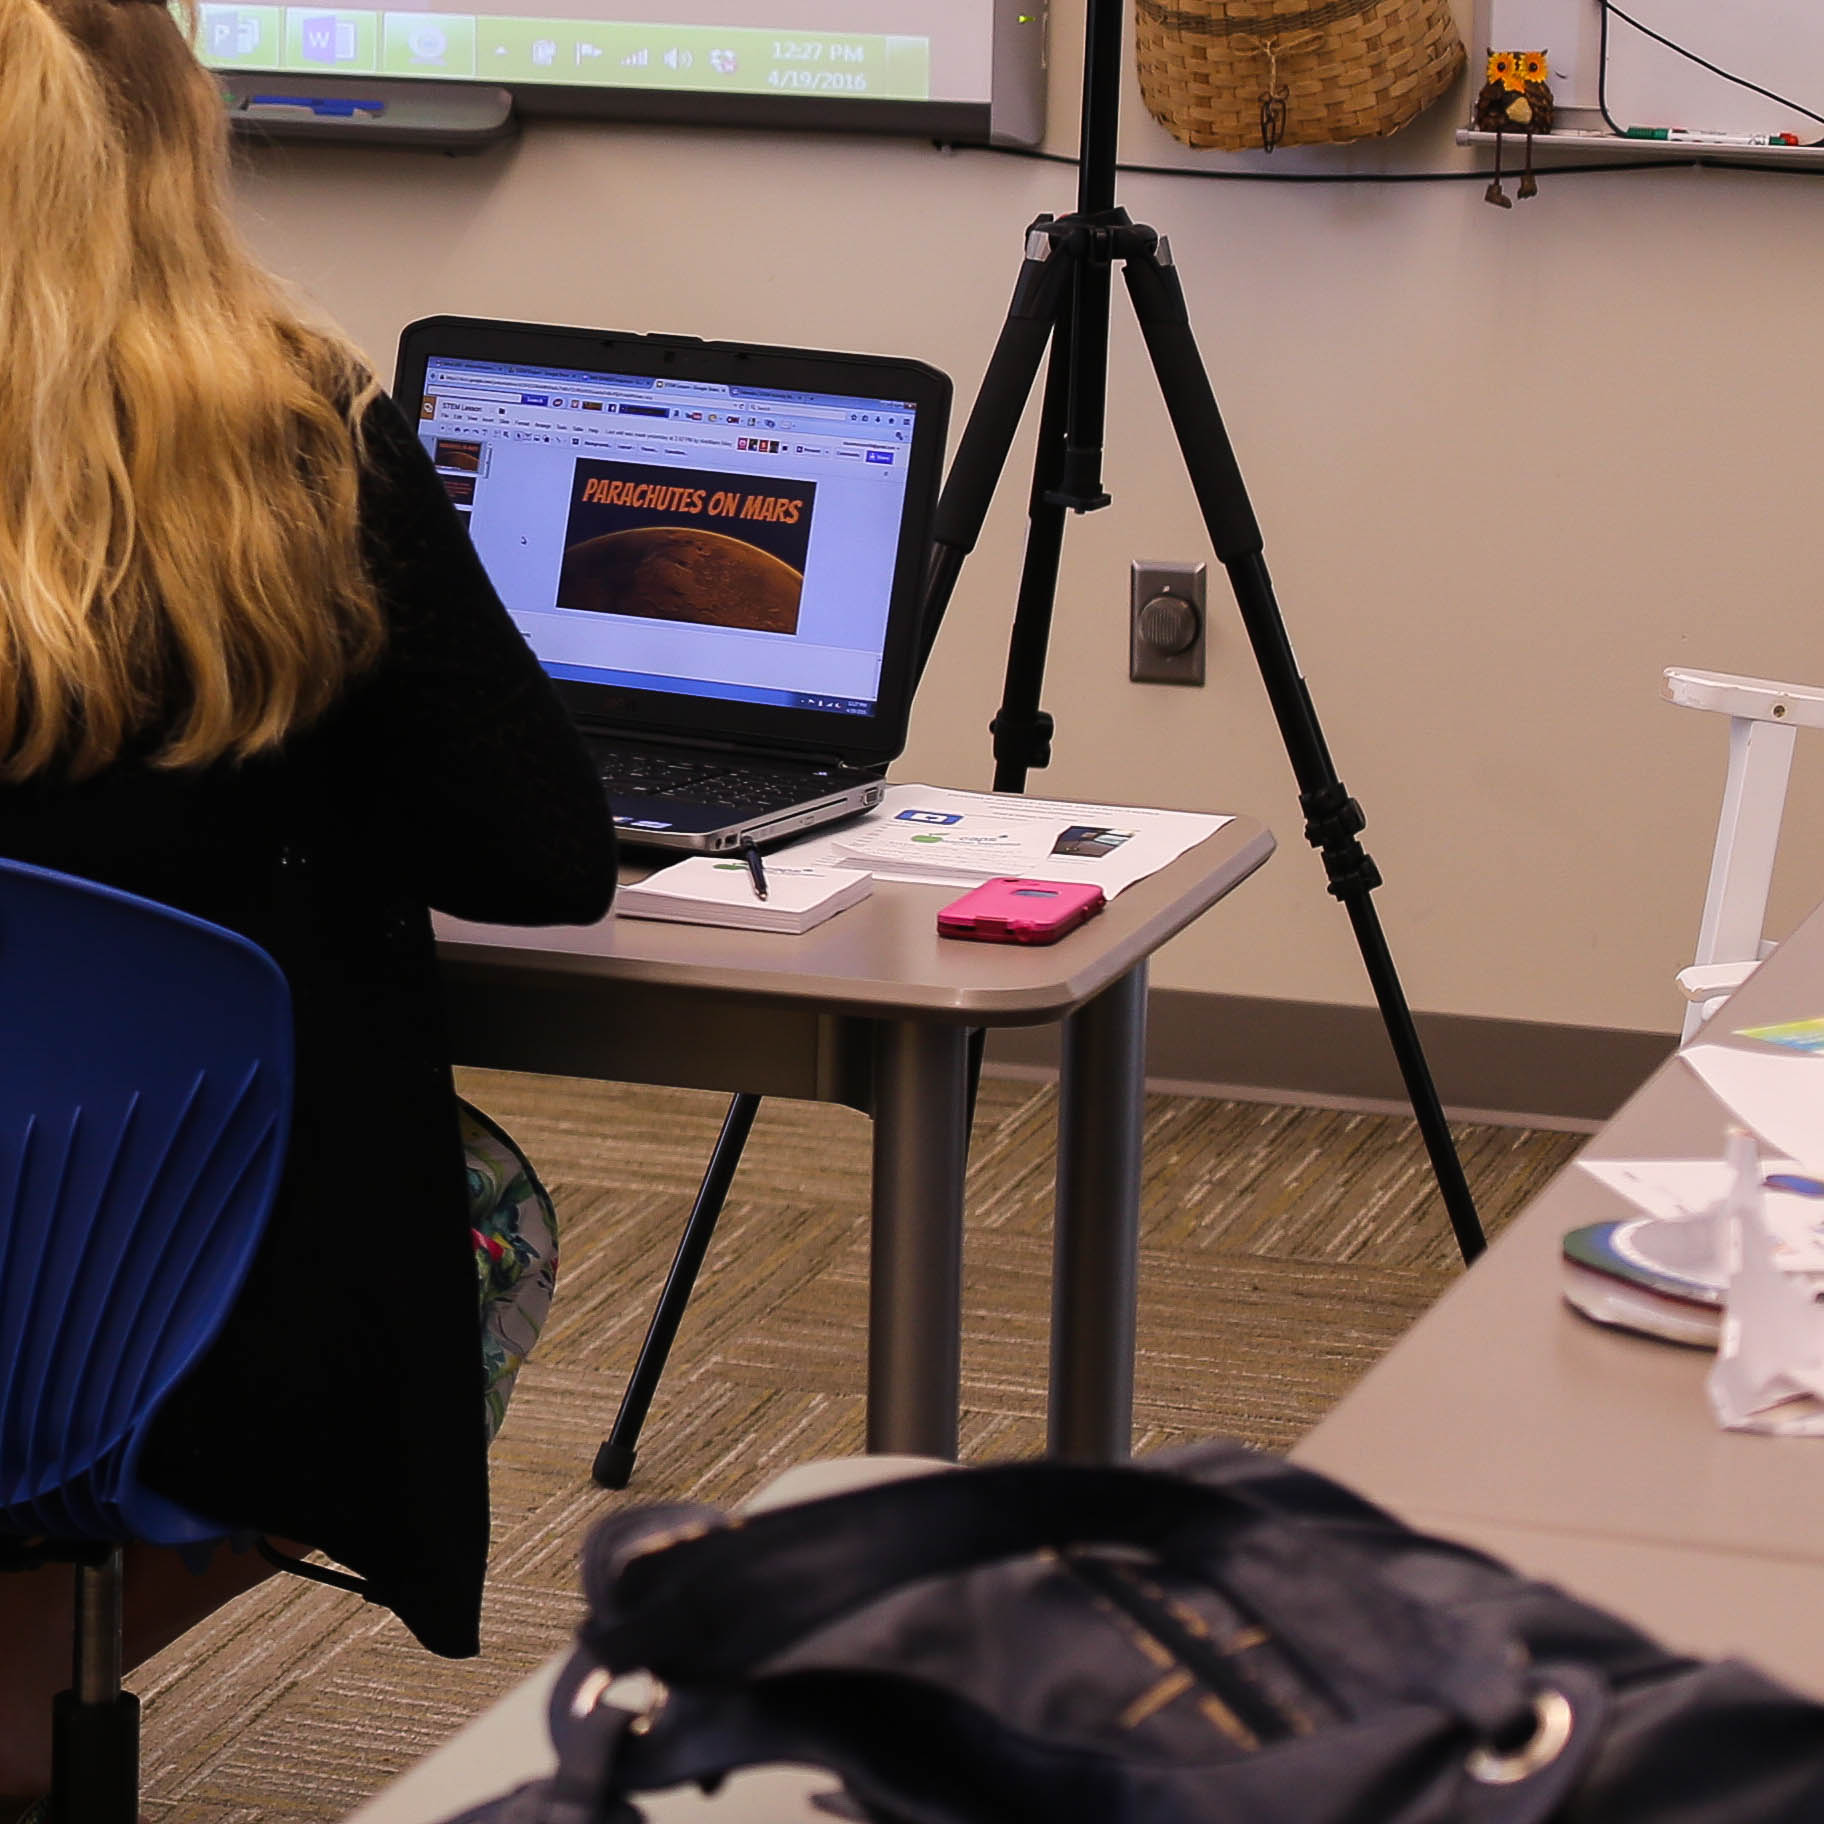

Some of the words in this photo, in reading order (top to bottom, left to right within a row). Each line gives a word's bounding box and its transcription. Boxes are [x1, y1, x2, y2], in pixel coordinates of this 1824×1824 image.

[582, 479, 706, 514] PARACHUTES
[707, 492, 740, 518] ON
[740, 495, 803, 525] MARS
